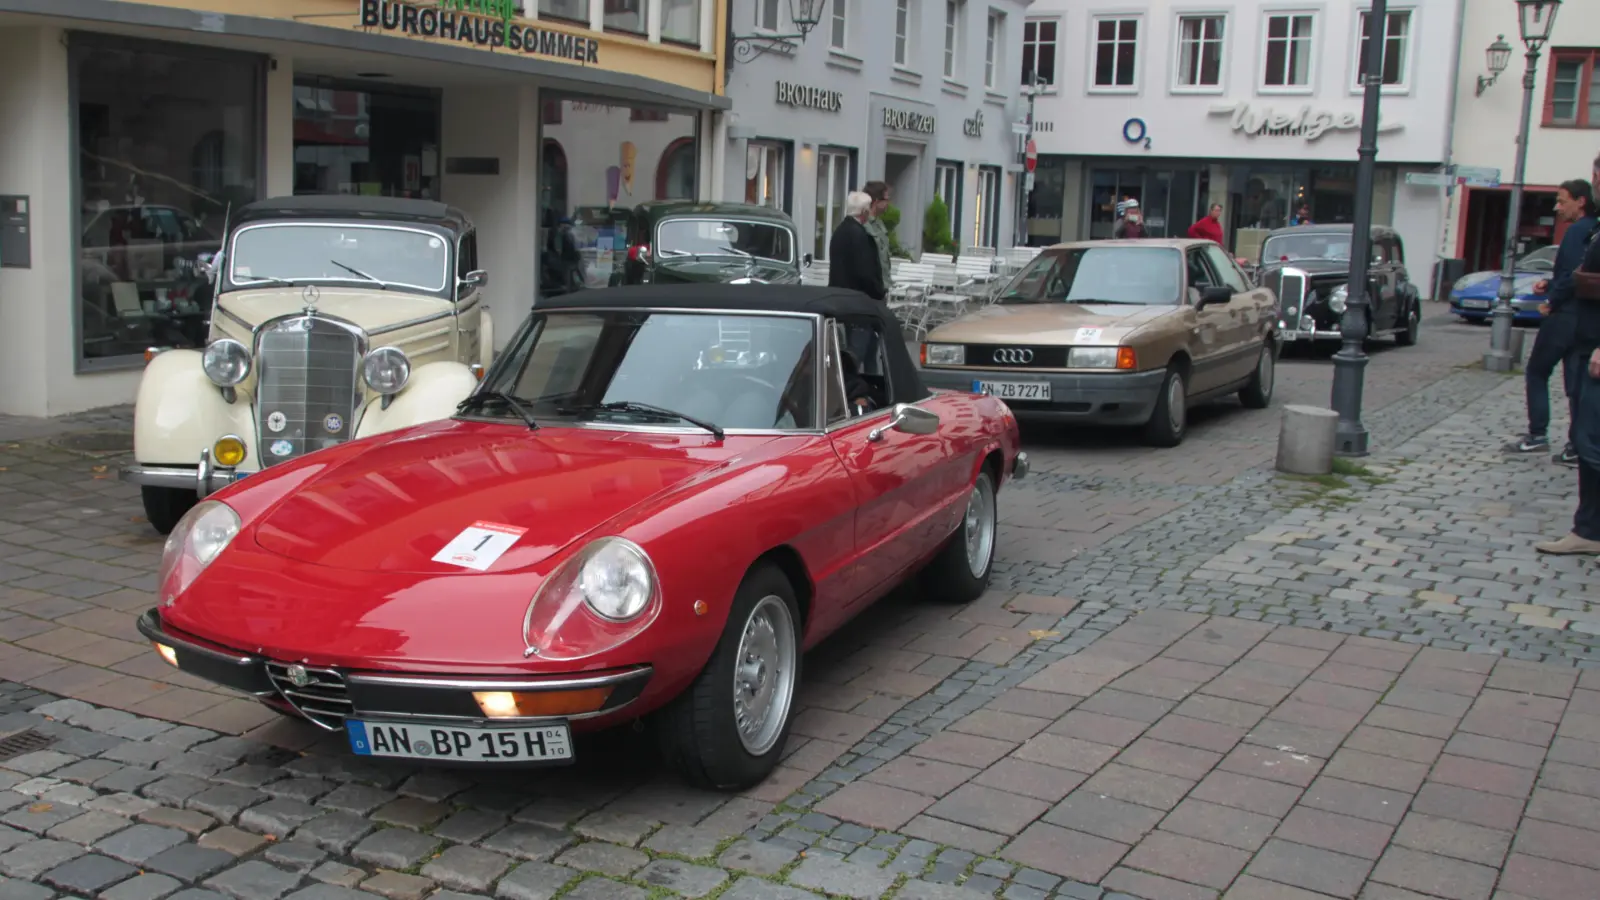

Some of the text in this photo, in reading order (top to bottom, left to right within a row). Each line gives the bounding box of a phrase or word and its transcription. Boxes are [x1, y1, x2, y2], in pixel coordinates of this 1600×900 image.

[508, 25, 598, 63] SOMMER
[472, 534, 494, 552] 1
[373, 726, 412, 753] AN
[431, 729, 471, 757] BP
